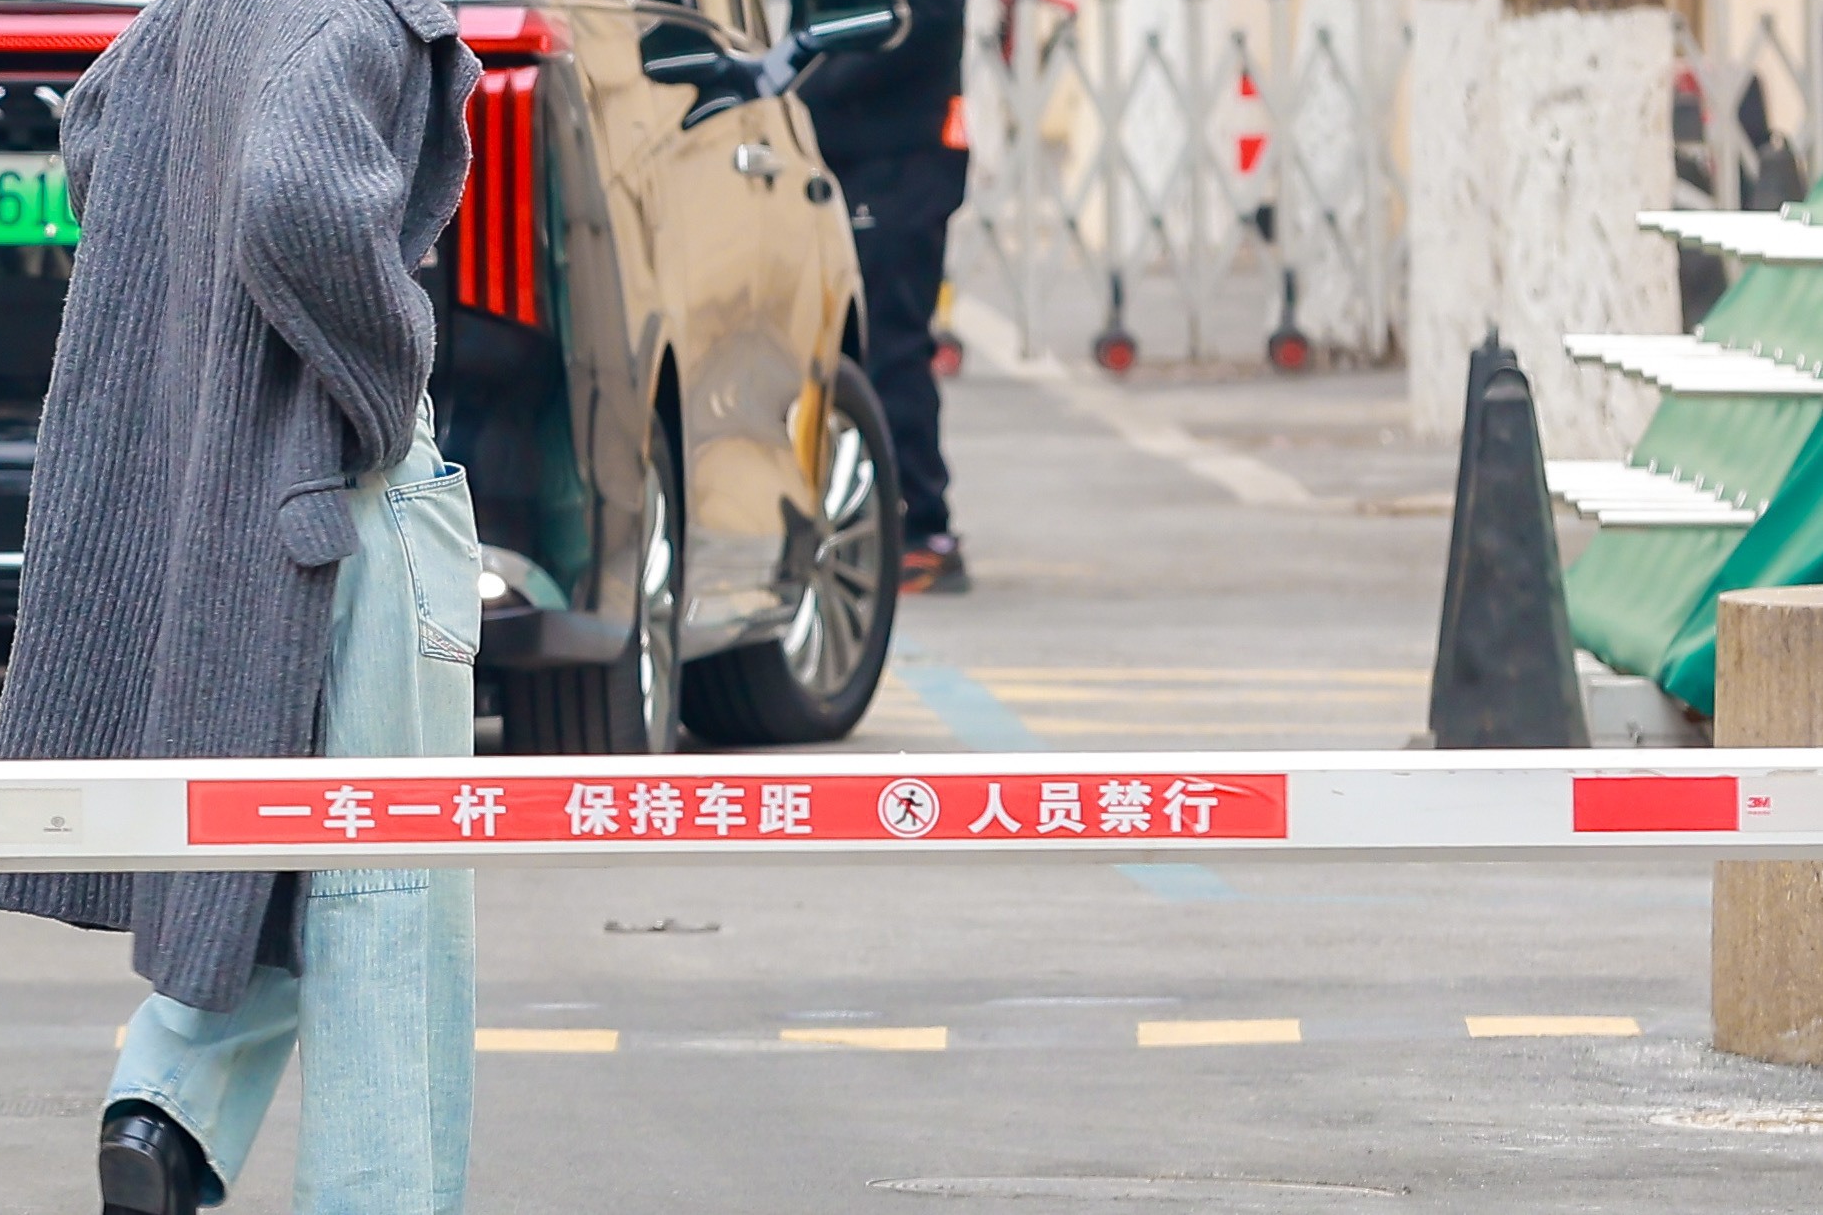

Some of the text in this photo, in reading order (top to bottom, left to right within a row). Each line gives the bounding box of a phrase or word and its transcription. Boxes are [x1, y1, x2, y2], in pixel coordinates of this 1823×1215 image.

[257, 779, 1219, 839] 一车一杆 保持车距 人员禁行
[1746, 795, 1771, 809] 3M
